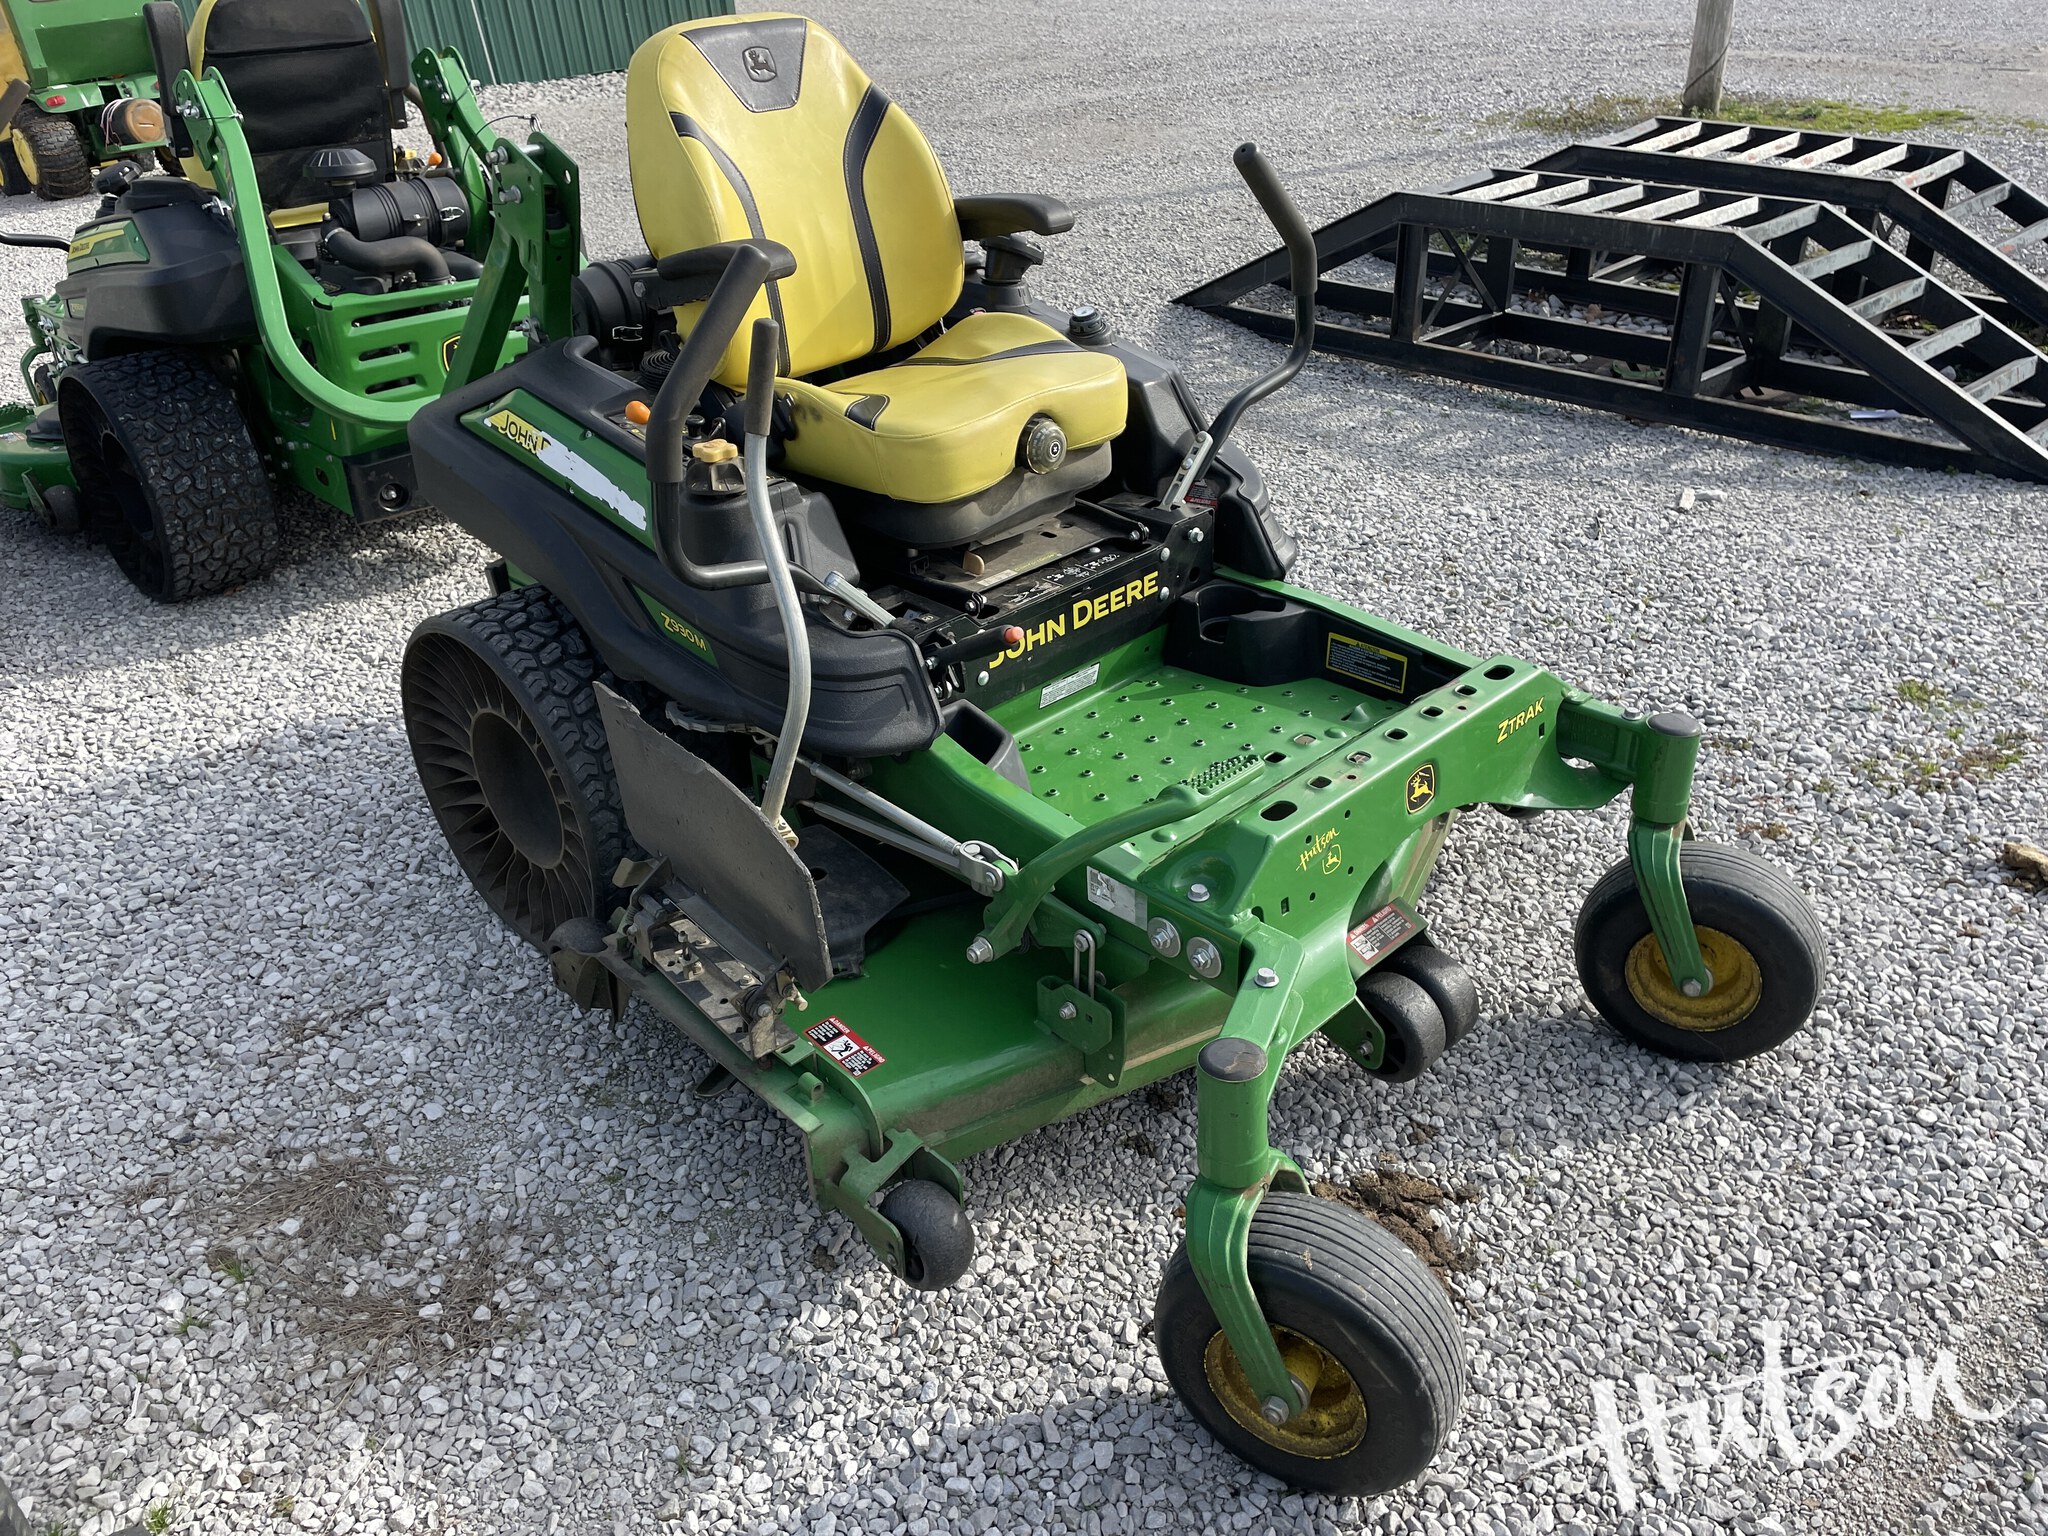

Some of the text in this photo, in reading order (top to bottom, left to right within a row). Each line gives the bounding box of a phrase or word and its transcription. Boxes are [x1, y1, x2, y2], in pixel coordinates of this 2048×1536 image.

[500, 414, 538, 452] JOHN
[1073, 571, 1159, 630] DEERE
[660, 611, 707, 651] Z930M
[1497, 696, 1544, 744] ZTRAK
[1296, 827, 1340, 871] Hutson
